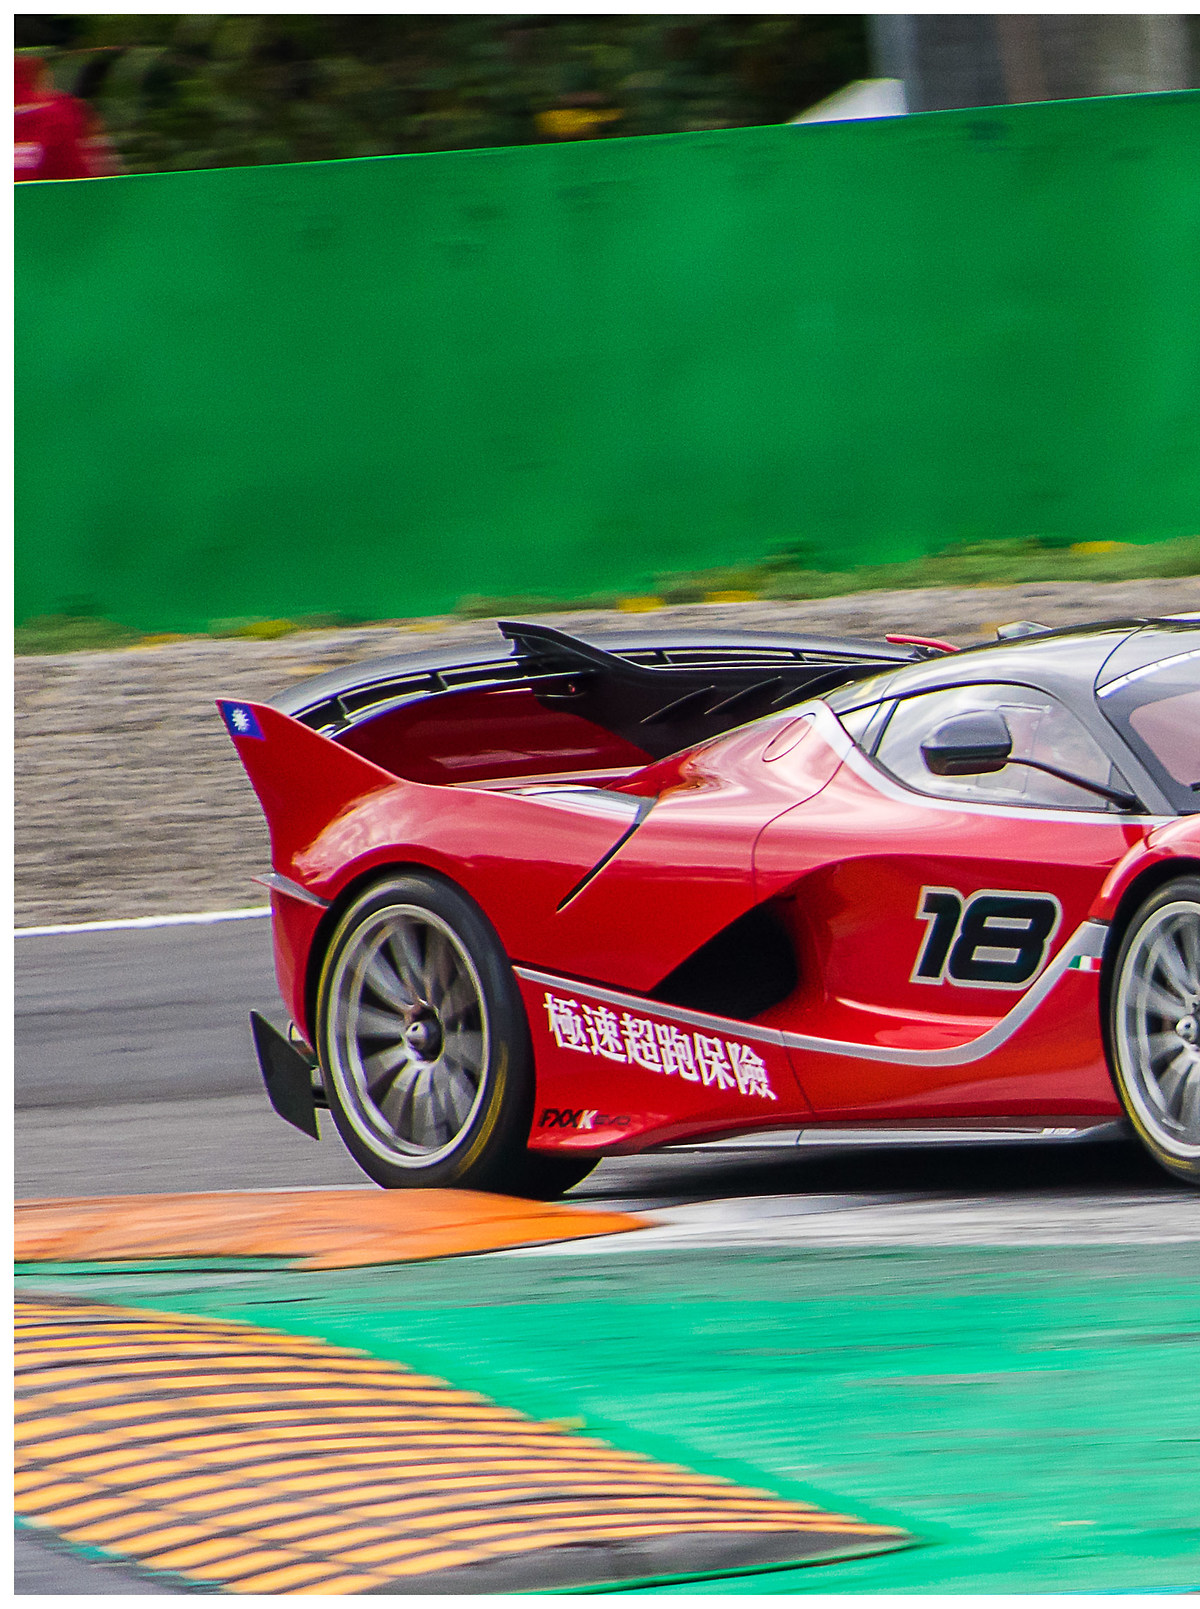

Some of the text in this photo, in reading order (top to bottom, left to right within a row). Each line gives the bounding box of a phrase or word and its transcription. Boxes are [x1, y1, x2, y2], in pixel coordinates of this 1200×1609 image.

[909, 885, 1063, 991] 18
[543, 992, 778, 1101] 極速超跑保險
